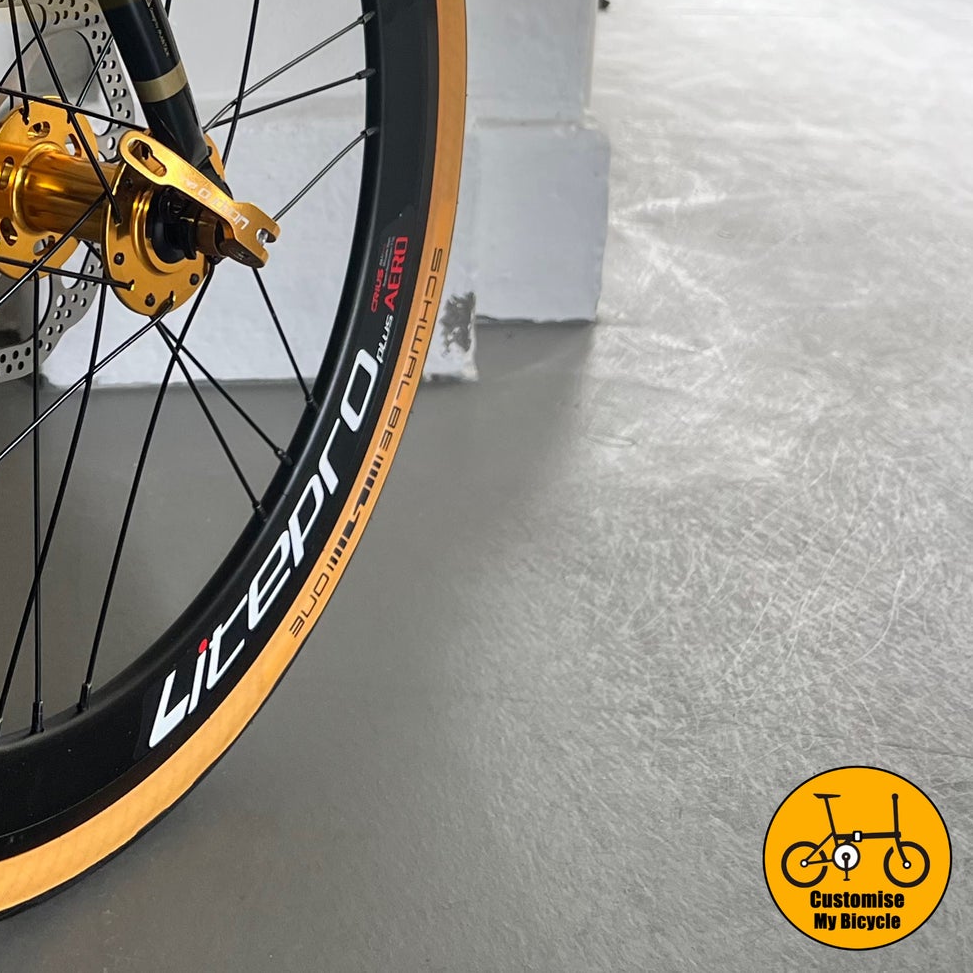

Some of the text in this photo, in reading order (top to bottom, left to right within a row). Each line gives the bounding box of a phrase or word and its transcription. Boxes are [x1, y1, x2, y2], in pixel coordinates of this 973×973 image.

[371, 268, 385, 313] CRIUS
[384, 236, 409, 312] AERO
[289, 248, 443, 639] SCHWALBE ONE
